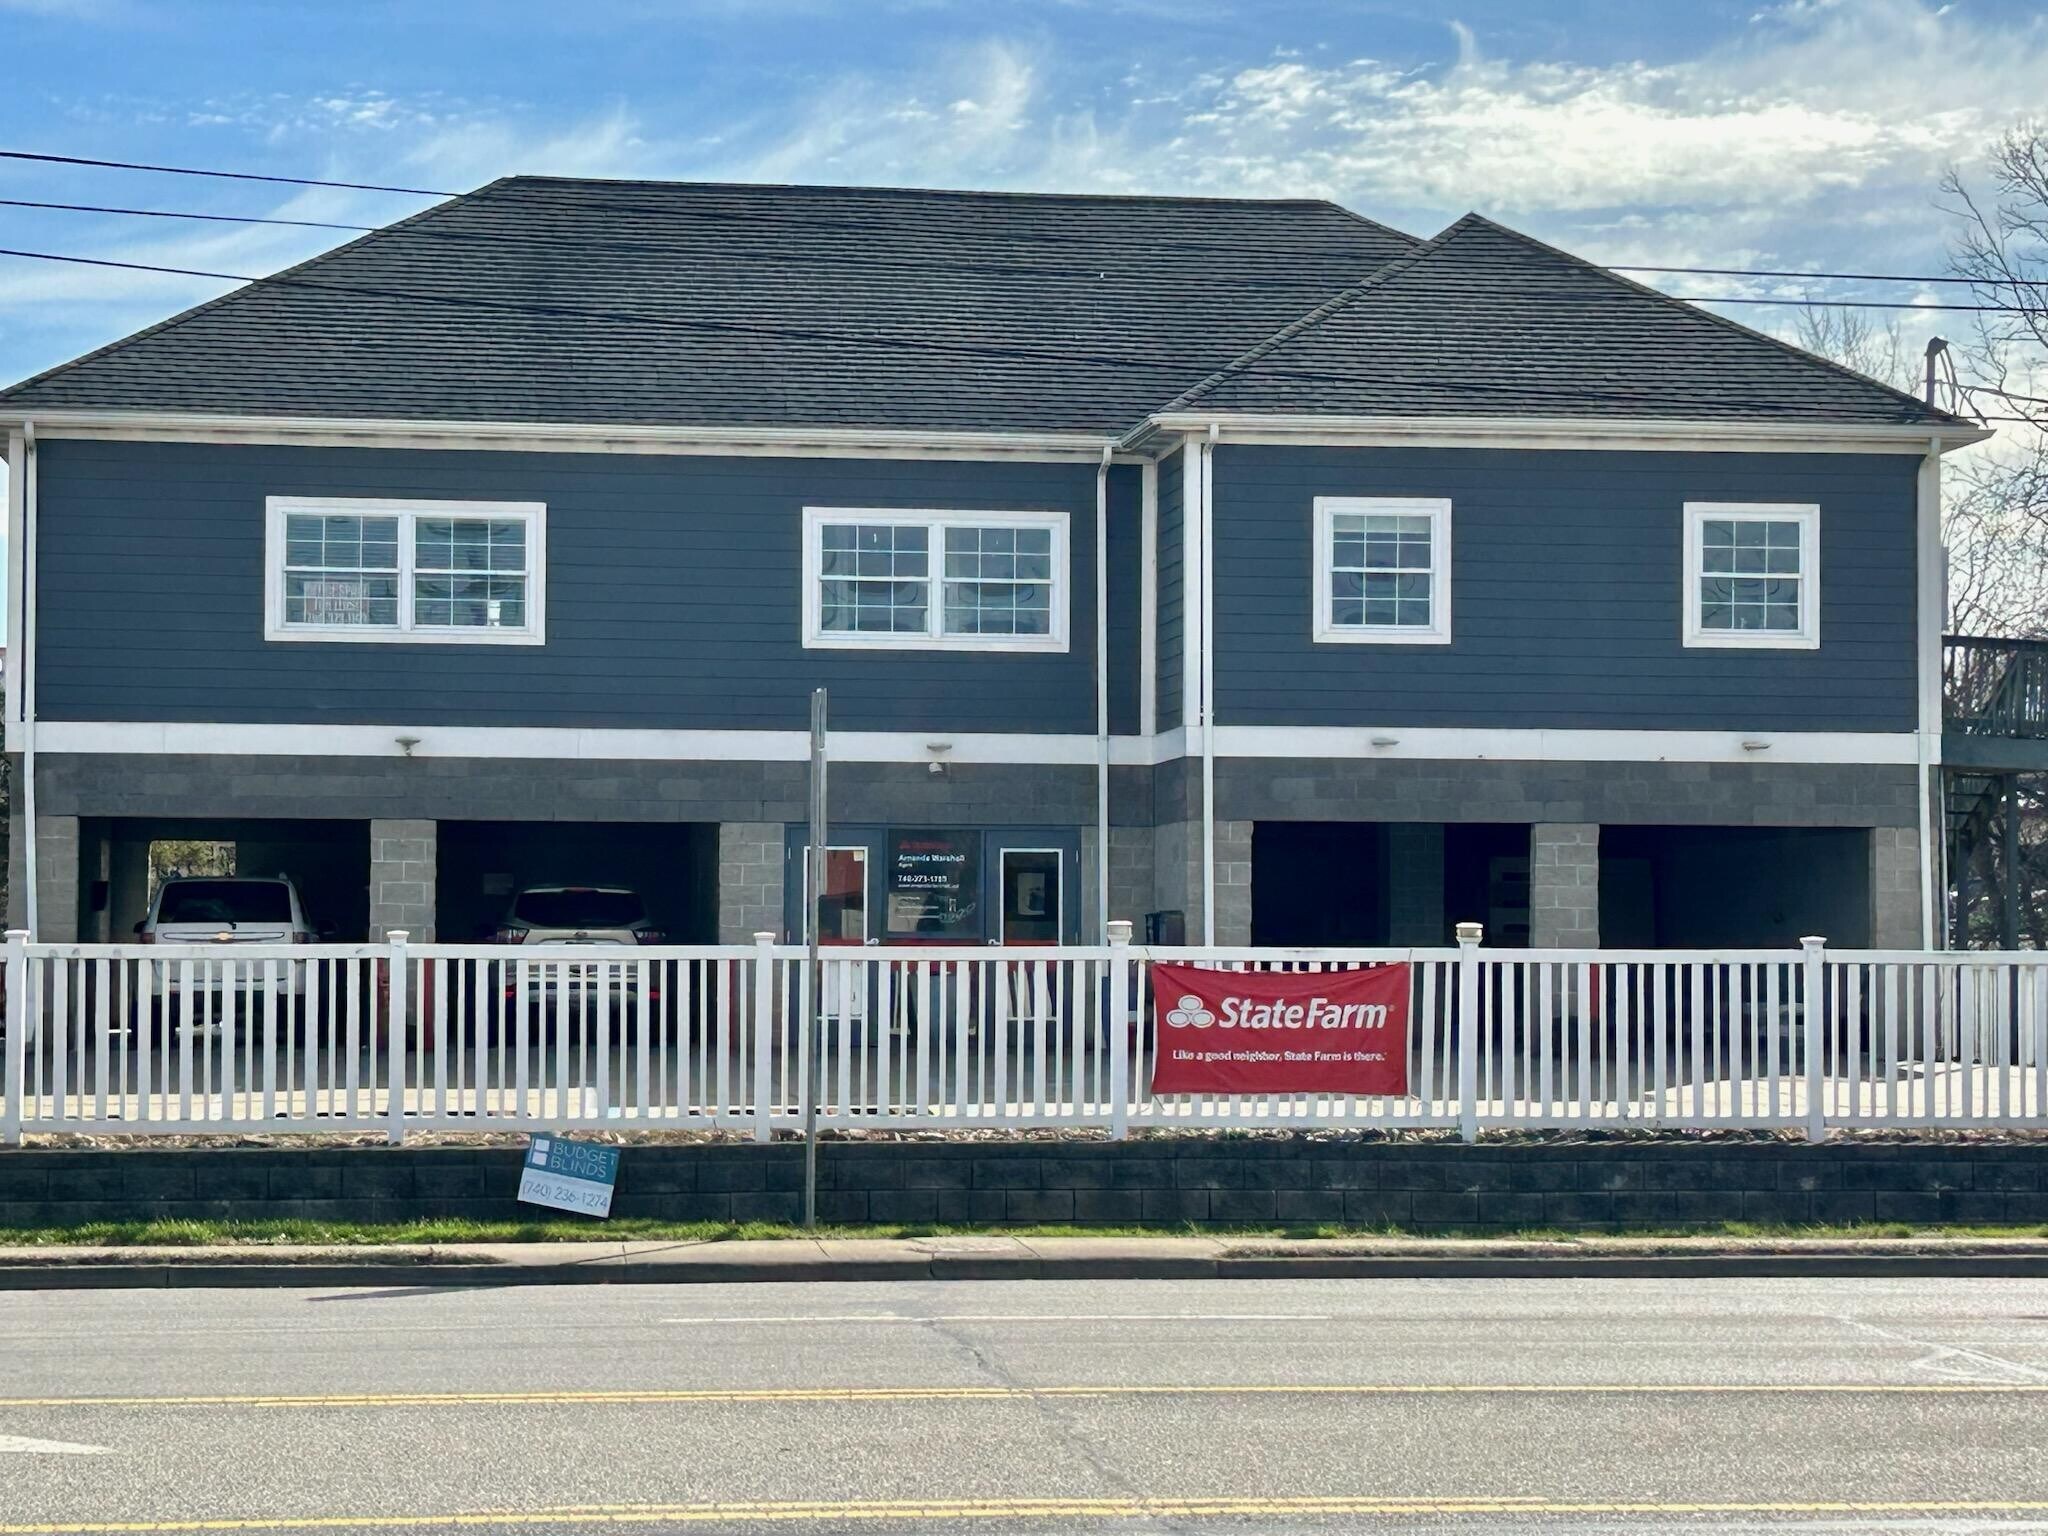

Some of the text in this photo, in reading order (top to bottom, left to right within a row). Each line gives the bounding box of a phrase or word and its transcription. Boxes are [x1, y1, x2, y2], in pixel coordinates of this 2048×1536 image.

[1172, 1049, 1194, 1060] Like
[1196, 1051, 1204, 1060] a
[1205, 1050, 1232, 1062] good
[1232, 1050, 1283, 1062] neighbor,
[1284, 1050, 1312, 1061] State
[1314, 1051, 1341, 1061] Farm
[1343, 1051, 1352, 1061] is
[553, 1143, 616, 1165] BUDGET
[551, 1156, 606, 1178] BLINDS
[523, 1182, 551, 1200] (740)
